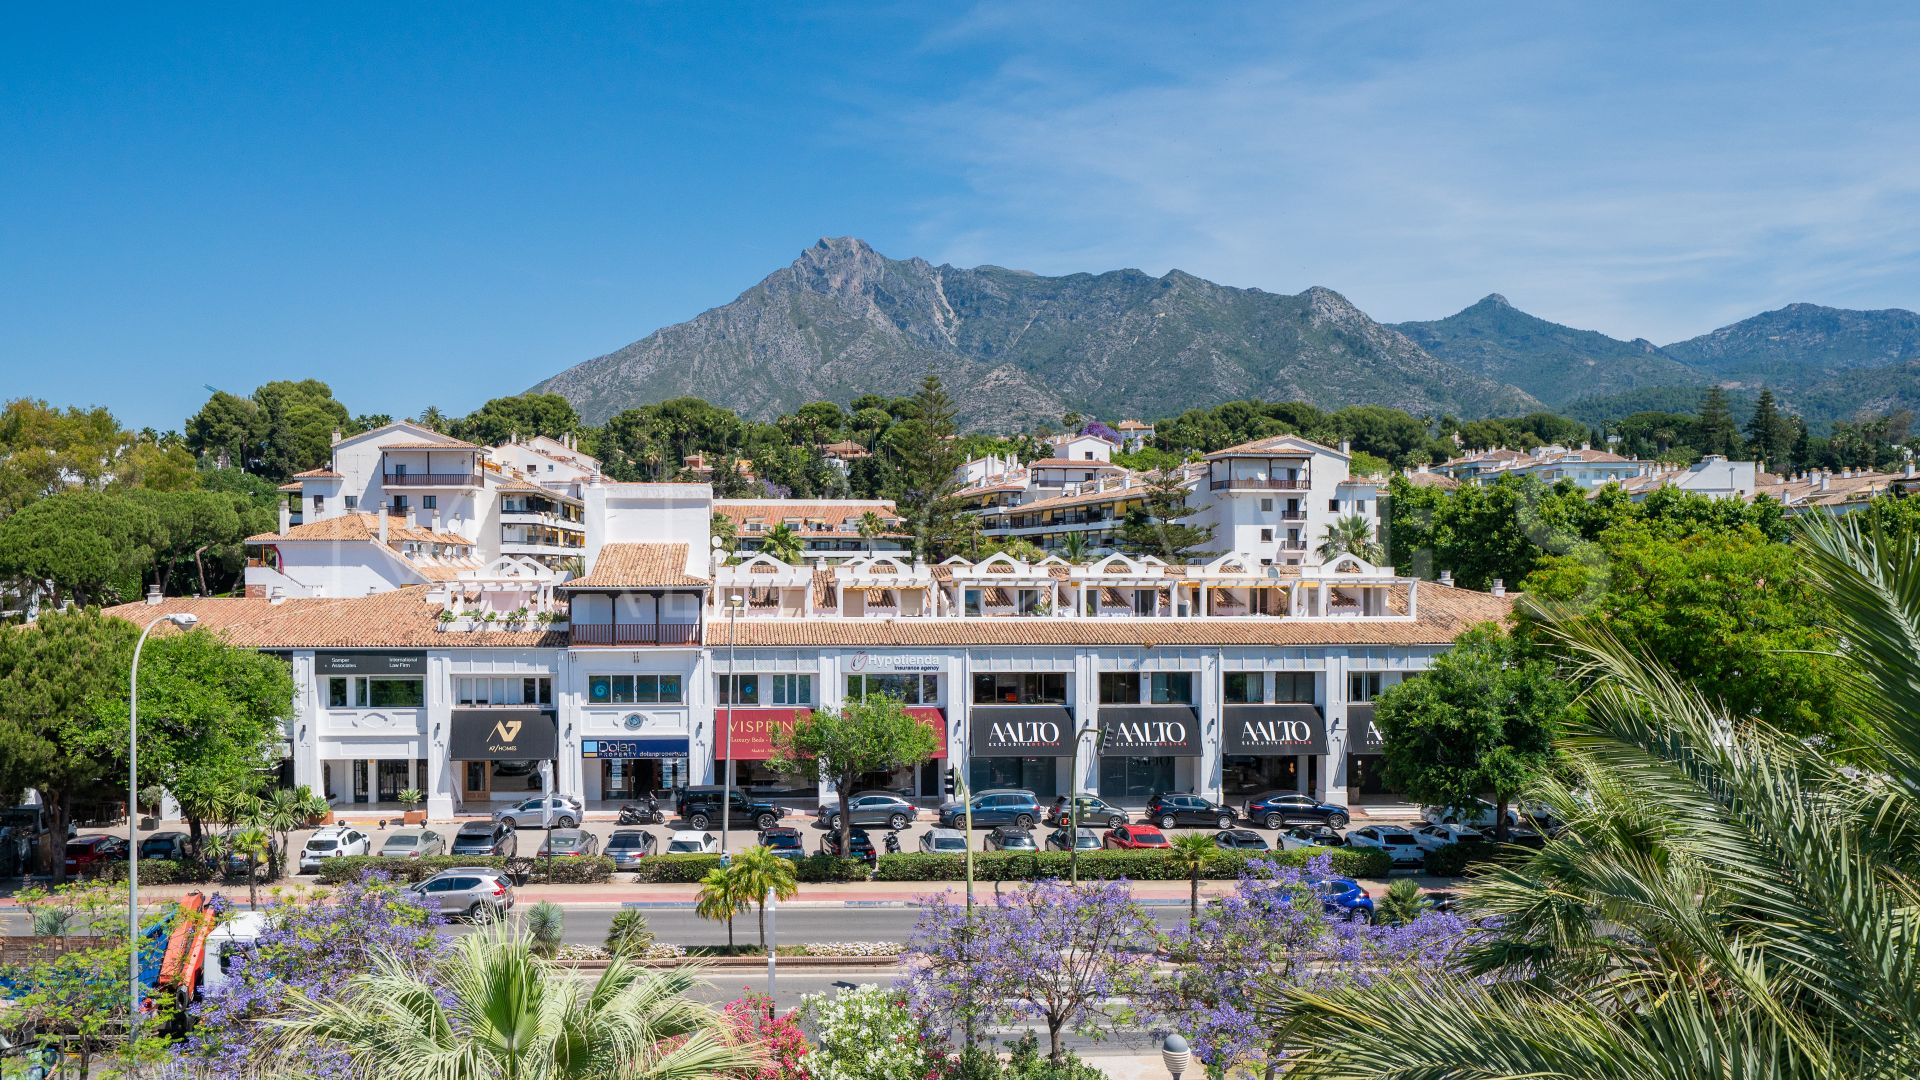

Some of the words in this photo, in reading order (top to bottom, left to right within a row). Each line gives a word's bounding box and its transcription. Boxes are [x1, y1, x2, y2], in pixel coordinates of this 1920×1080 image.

[868, 654, 939, 667] Hypotienda
[989, 721, 1060, 743] AALTO
[1116, 721, 1186, 743] AALTO
[1241, 720, 1311, 742] AALTO
[598, 741, 637, 752] Dolan
